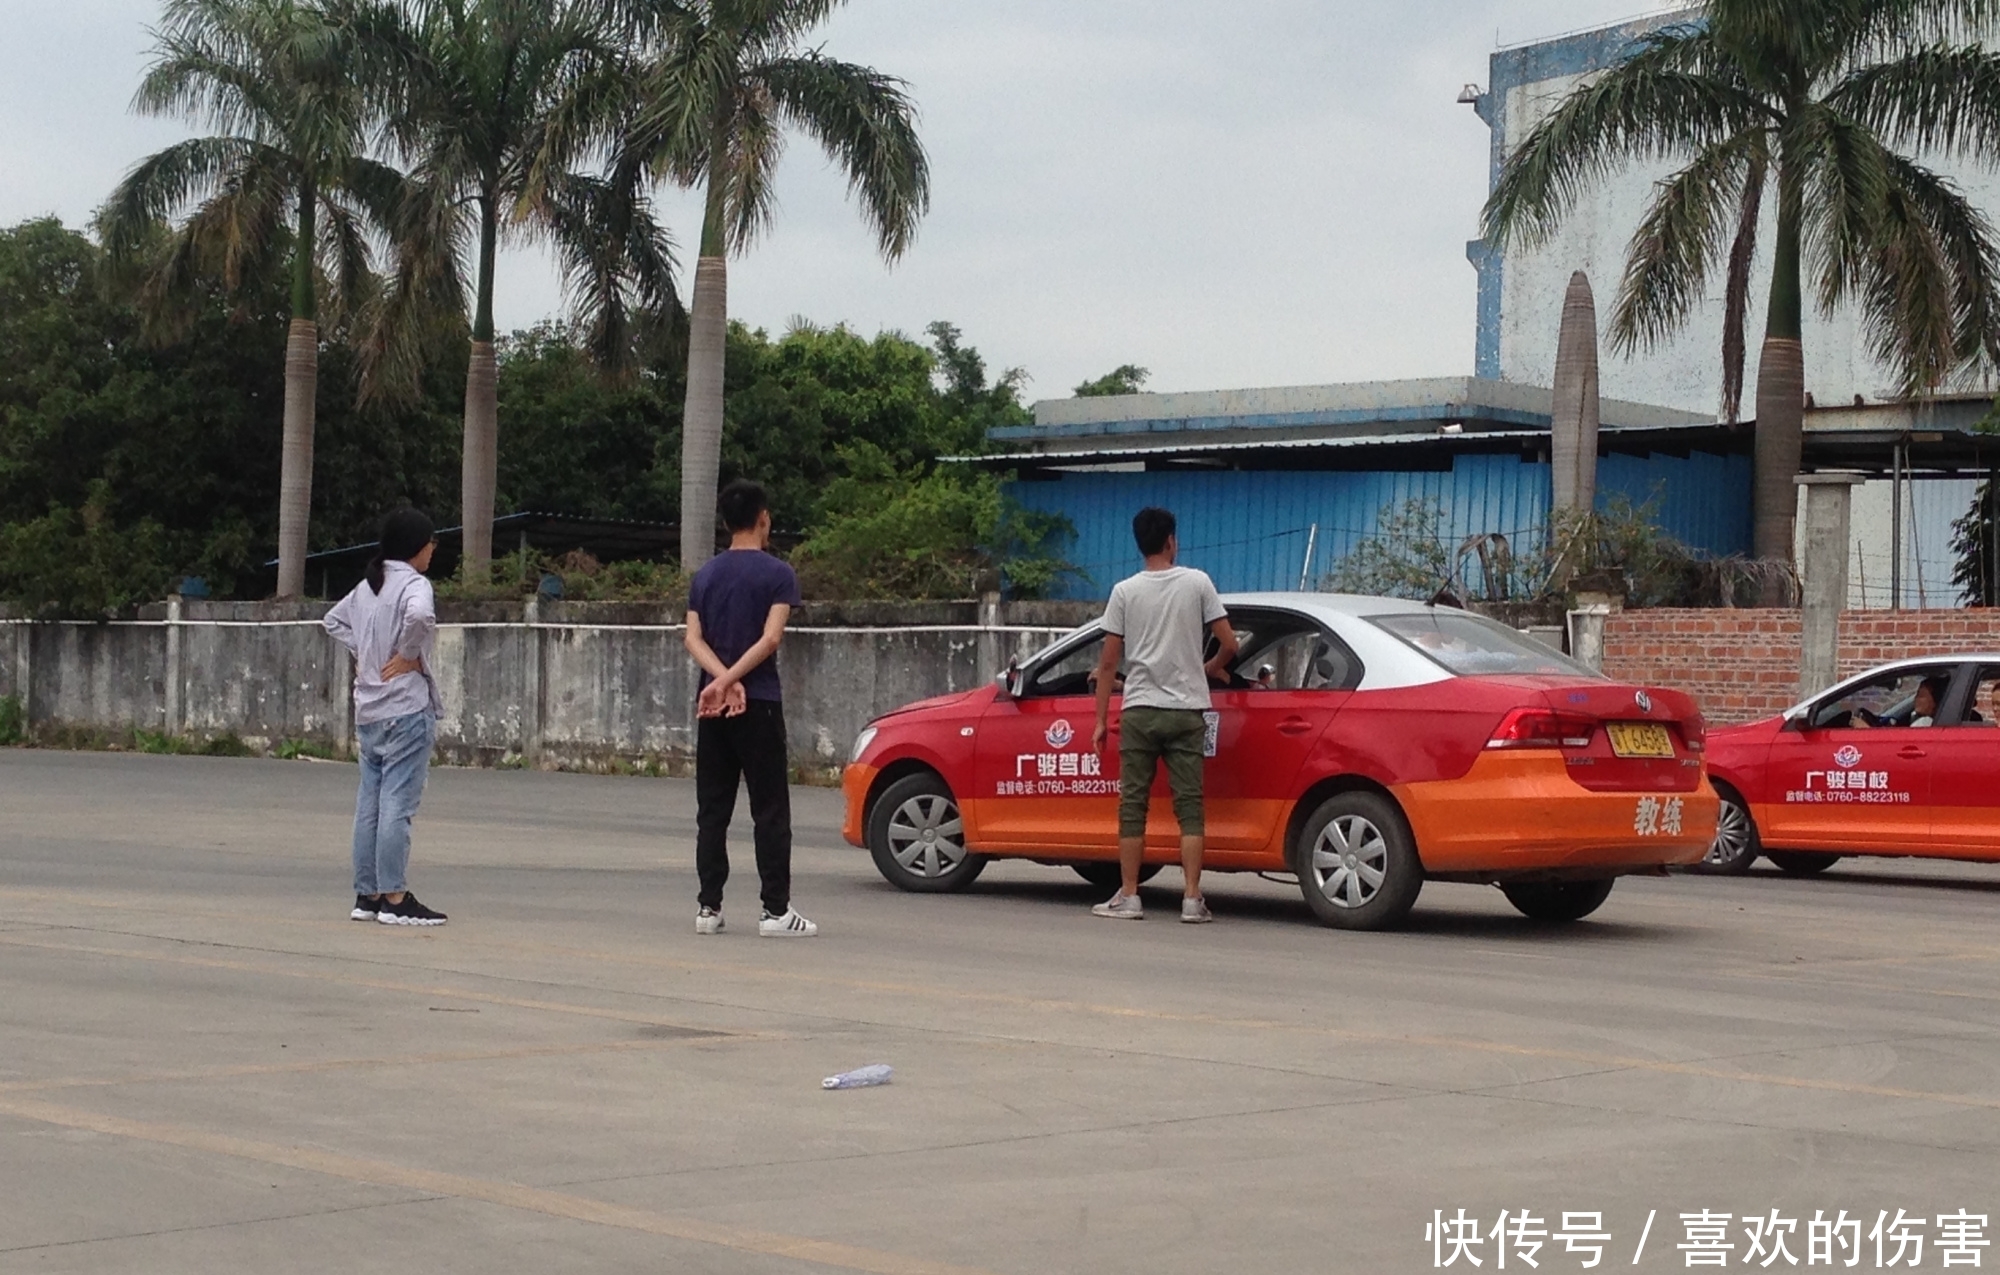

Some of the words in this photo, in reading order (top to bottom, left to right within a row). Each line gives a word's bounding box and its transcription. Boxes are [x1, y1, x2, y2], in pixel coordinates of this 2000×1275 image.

[1016, 753, 1101, 777] 广骏驾校
[1806, 770, 1889, 789] 广骏驾校
[1634, 795, 1684, 836] 教练
